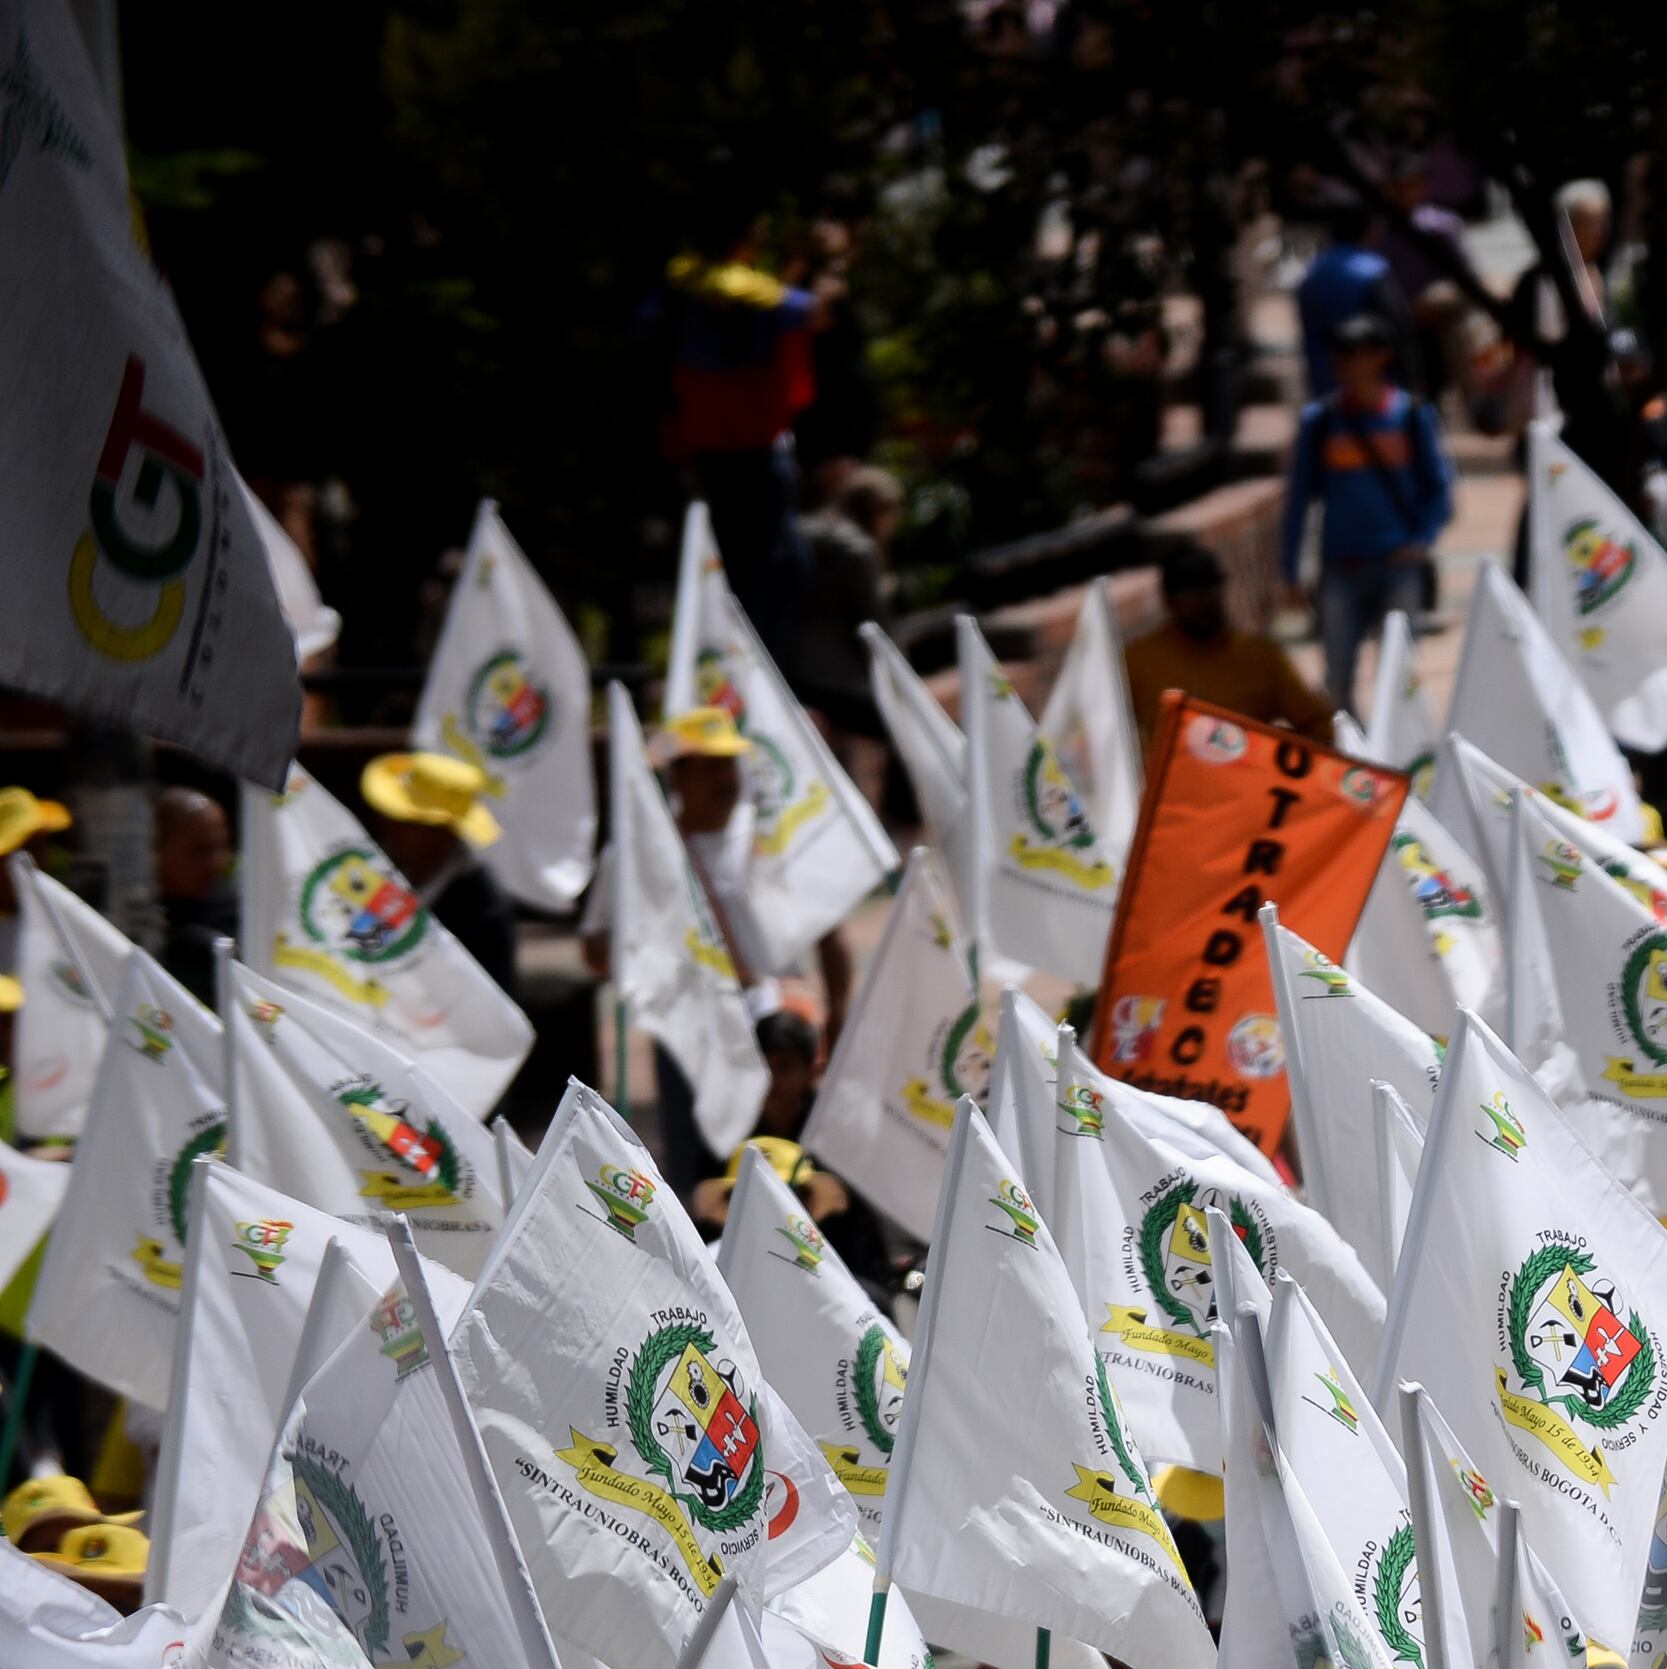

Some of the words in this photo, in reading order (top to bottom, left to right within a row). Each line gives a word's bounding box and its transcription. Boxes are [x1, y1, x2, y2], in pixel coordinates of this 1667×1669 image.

[1140, 1166, 1186, 1204] TRABAJO
[1123, 1225, 1143, 1292] HUMILDAD
[1250, 1199, 1277, 1286] HONESTIDAD
[1537, 1229, 1588, 1250] TRABAJO
[650, 1307, 707, 1327] TRABAJO
[1497, 1270, 1511, 1352] HUMILDAD
[1122, 1328, 1171, 1350] Fundado
[1175, 1339, 1210, 1359] Mayo
[607, 1347, 628, 1429] HUMILDAD
[1104, 1351, 1215, 1395] TRAUNIOBRAS
[836, 1359, 856, 1432] HUMILDAD
[1084, 1374, 1109, 1456] HUMILDAD
[1519, 1403, 1548, 1430] Mayo
[1545, 1422, 1560, 1439] 15
[1559, 1433, 1578, 1452] de
[1572, 1446, 1599, 1479] 1934
[578, 1464, 638, 1503] Fundado
[1539, 1468, 1599, 1520] BOGOTA
[636, 1487, 675, 1522] Mayo
[1089, 1495, 1139, 1524] Fundado
[673, 1515, 690, 1537] 15
[681, 1536, 700, 1555] de
[720, 1528, 760, 1557] SERVICIO
[1039, 1504, 1171, 1581] “SINTRAUNIOBRAS
[645, 1545, 705, 1615] BOGO
[690, 1553, 717, 1592] 1934
